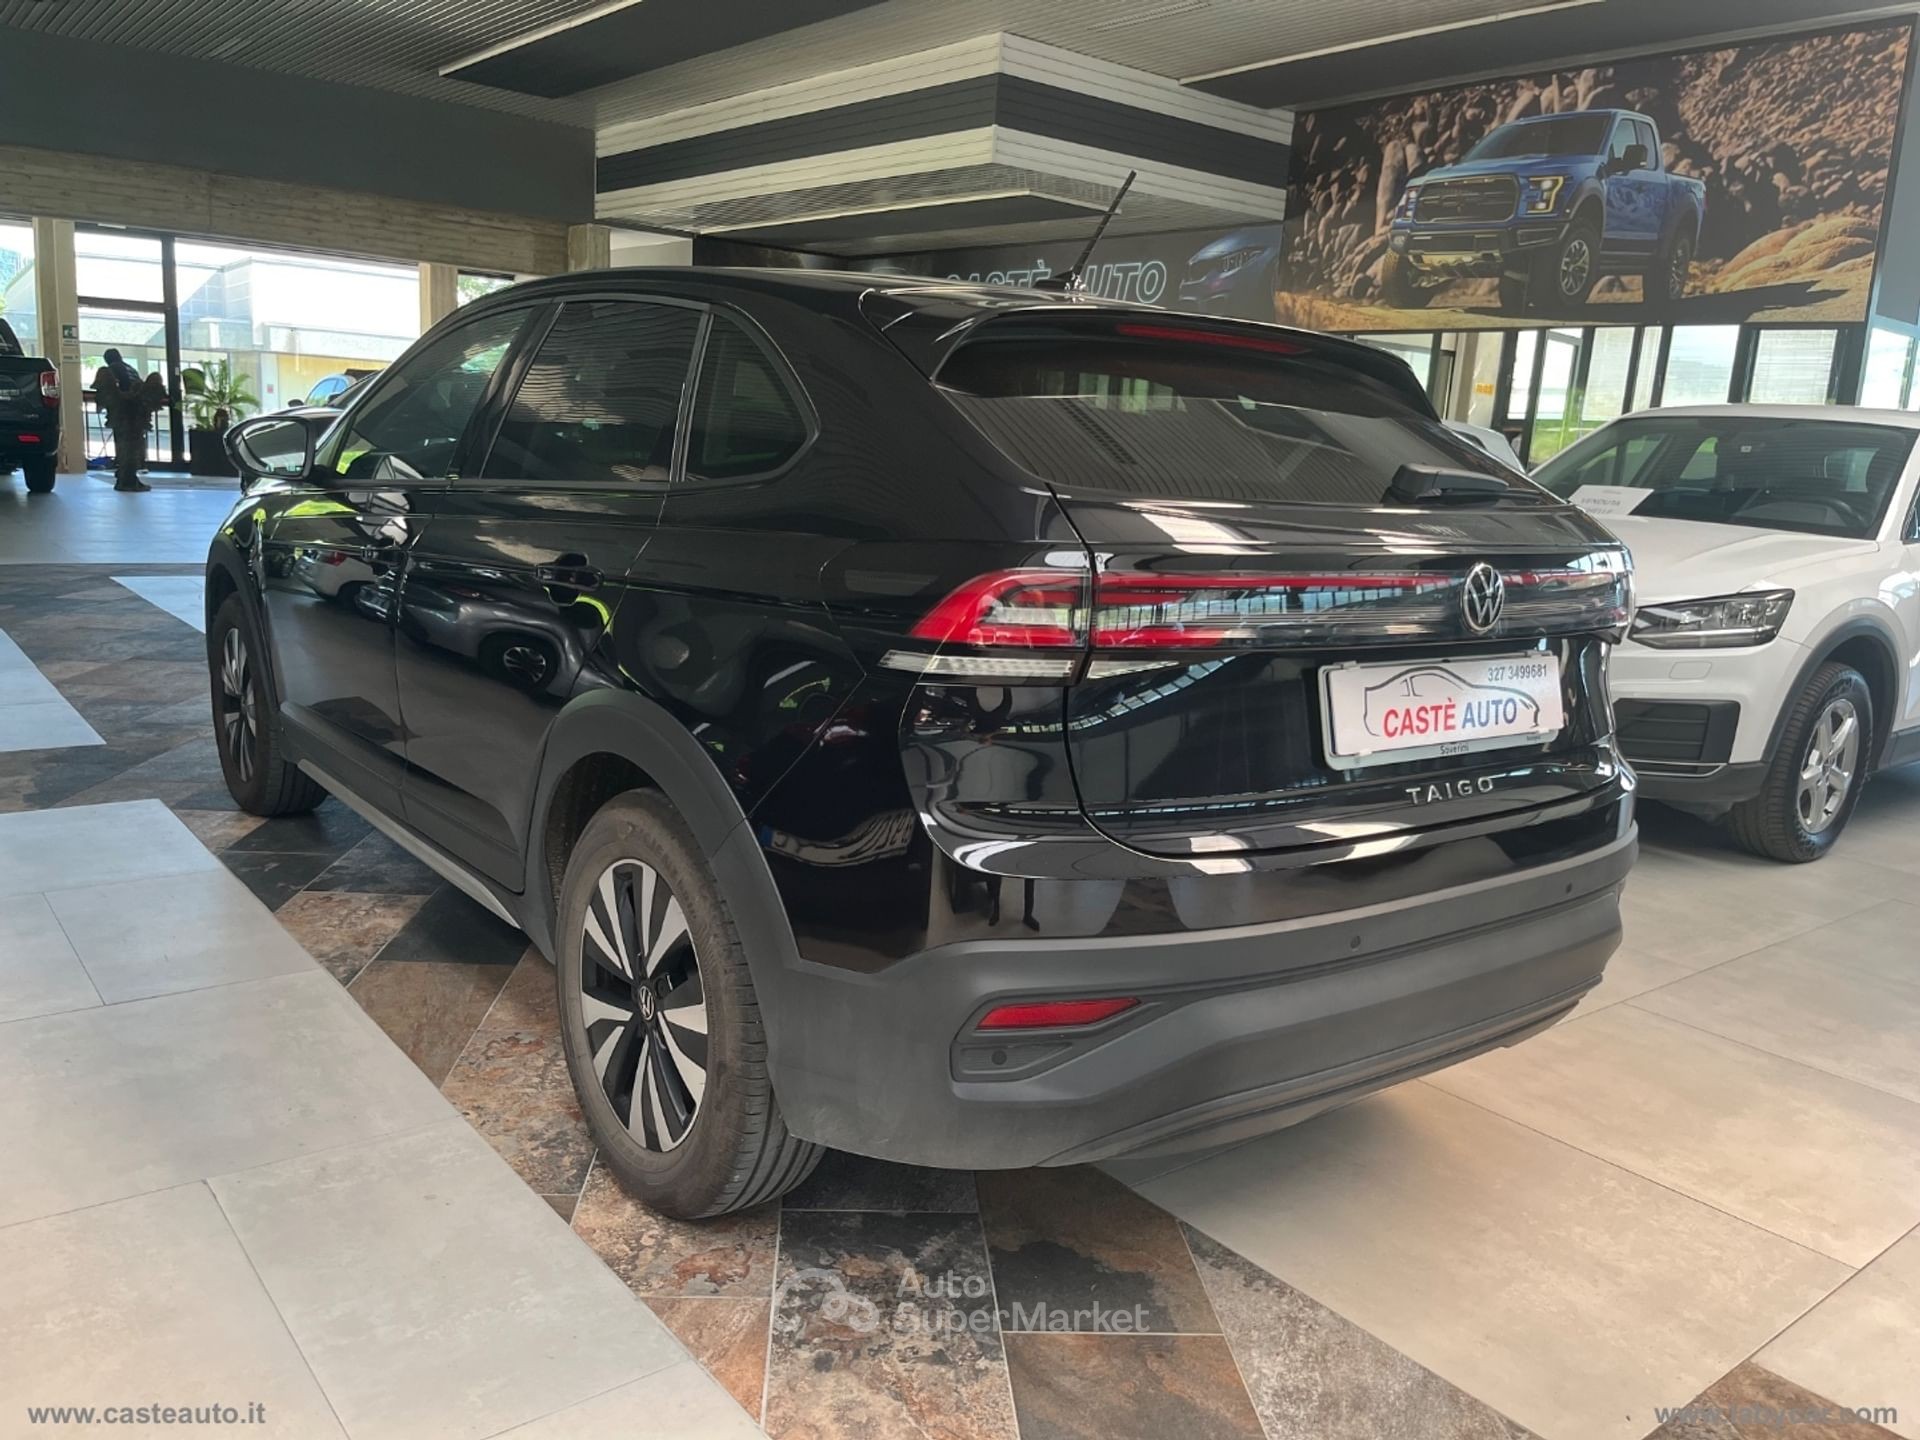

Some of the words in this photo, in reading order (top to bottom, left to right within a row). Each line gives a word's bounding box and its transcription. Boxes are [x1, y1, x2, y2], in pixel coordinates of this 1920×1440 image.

[1082, 261, 1167, 303] UTO
[1488, 666, 1506, 682] 327
[1508, 664, 1547, 680] 3499681
[1383, 697, 1457, 738] CASTÈ
[1461, 697, 1518, 730] AUTO
[1404, 776, 1494, 805] TAIGO
